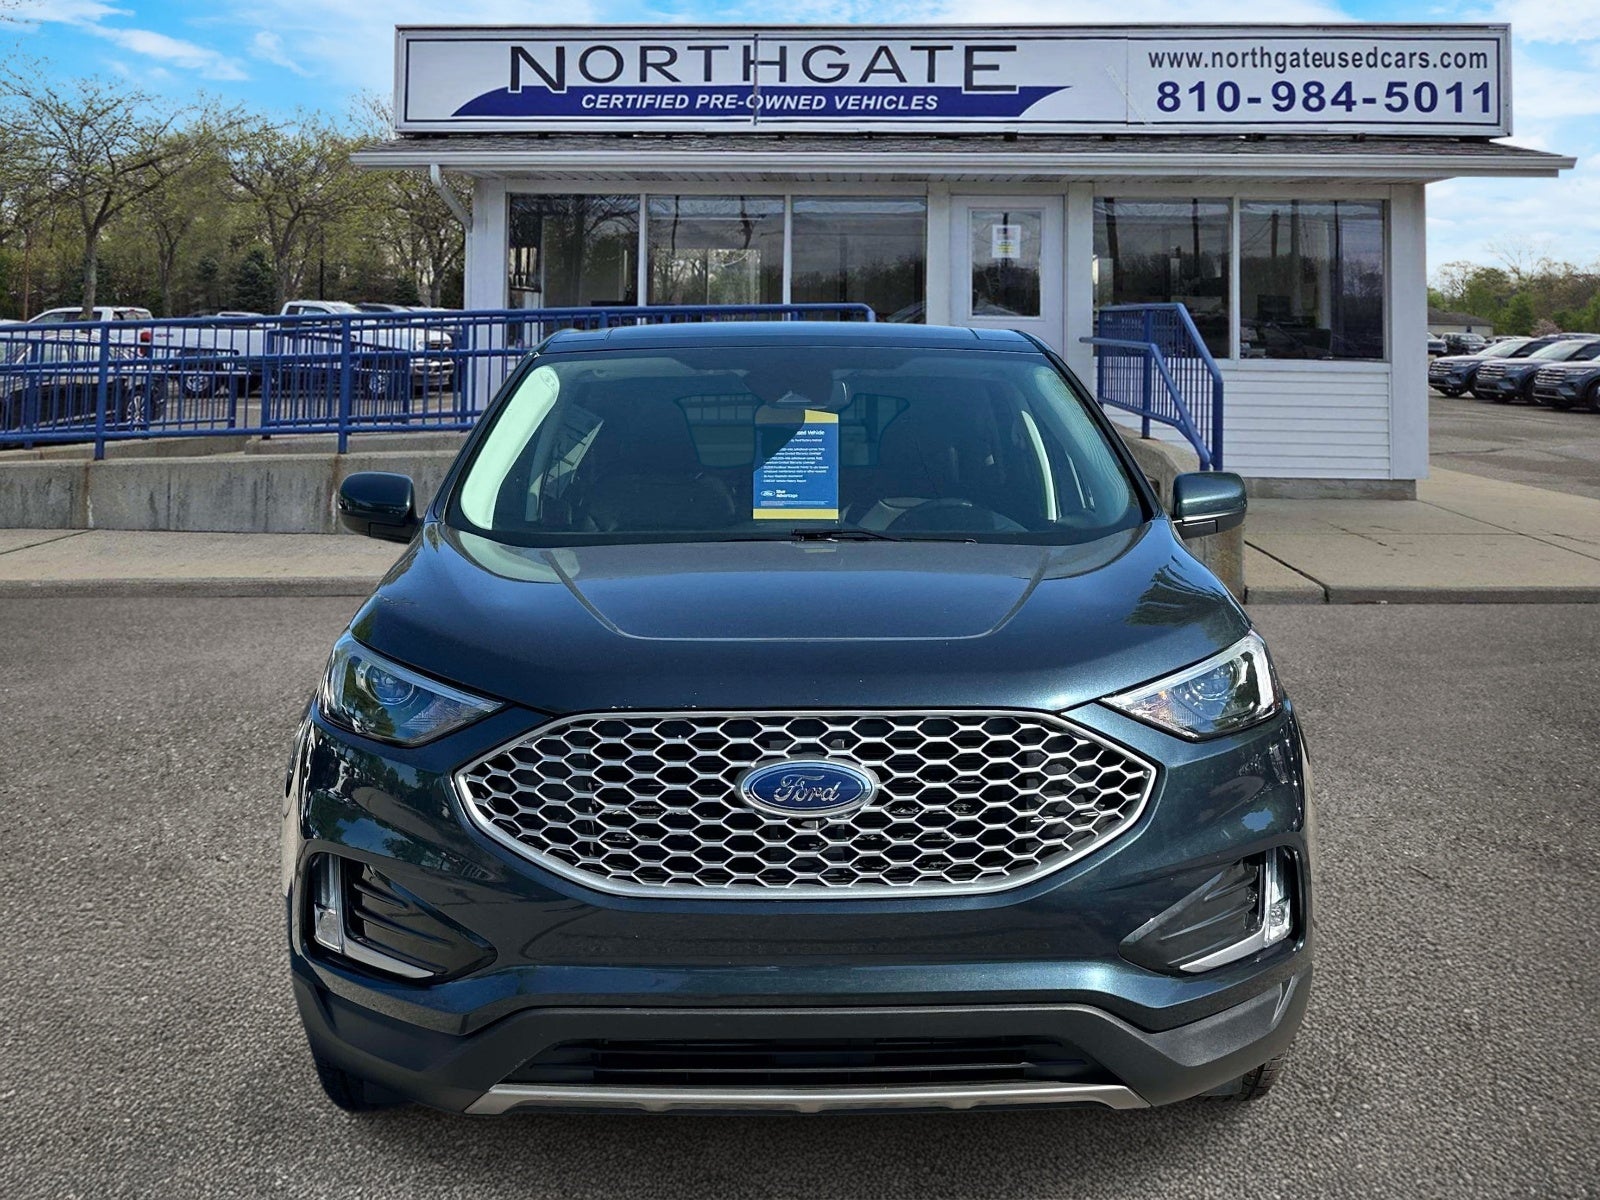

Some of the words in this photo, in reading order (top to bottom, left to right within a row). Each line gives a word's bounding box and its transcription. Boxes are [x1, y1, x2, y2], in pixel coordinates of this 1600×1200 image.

[510, 45, 1017, 91] NORTHGATE
[1148, 46, 1488, 74] www.northgateusedcars.com
[581, 94, 689, 109] CERTIFIED
[695, 94, 826, 110] PRE-OWNED
[834, 95, 938, 110] VEHICLES
[1156, 80, 1490, 113] 810-984-5011
[773, 774, 841, 802] Ford
